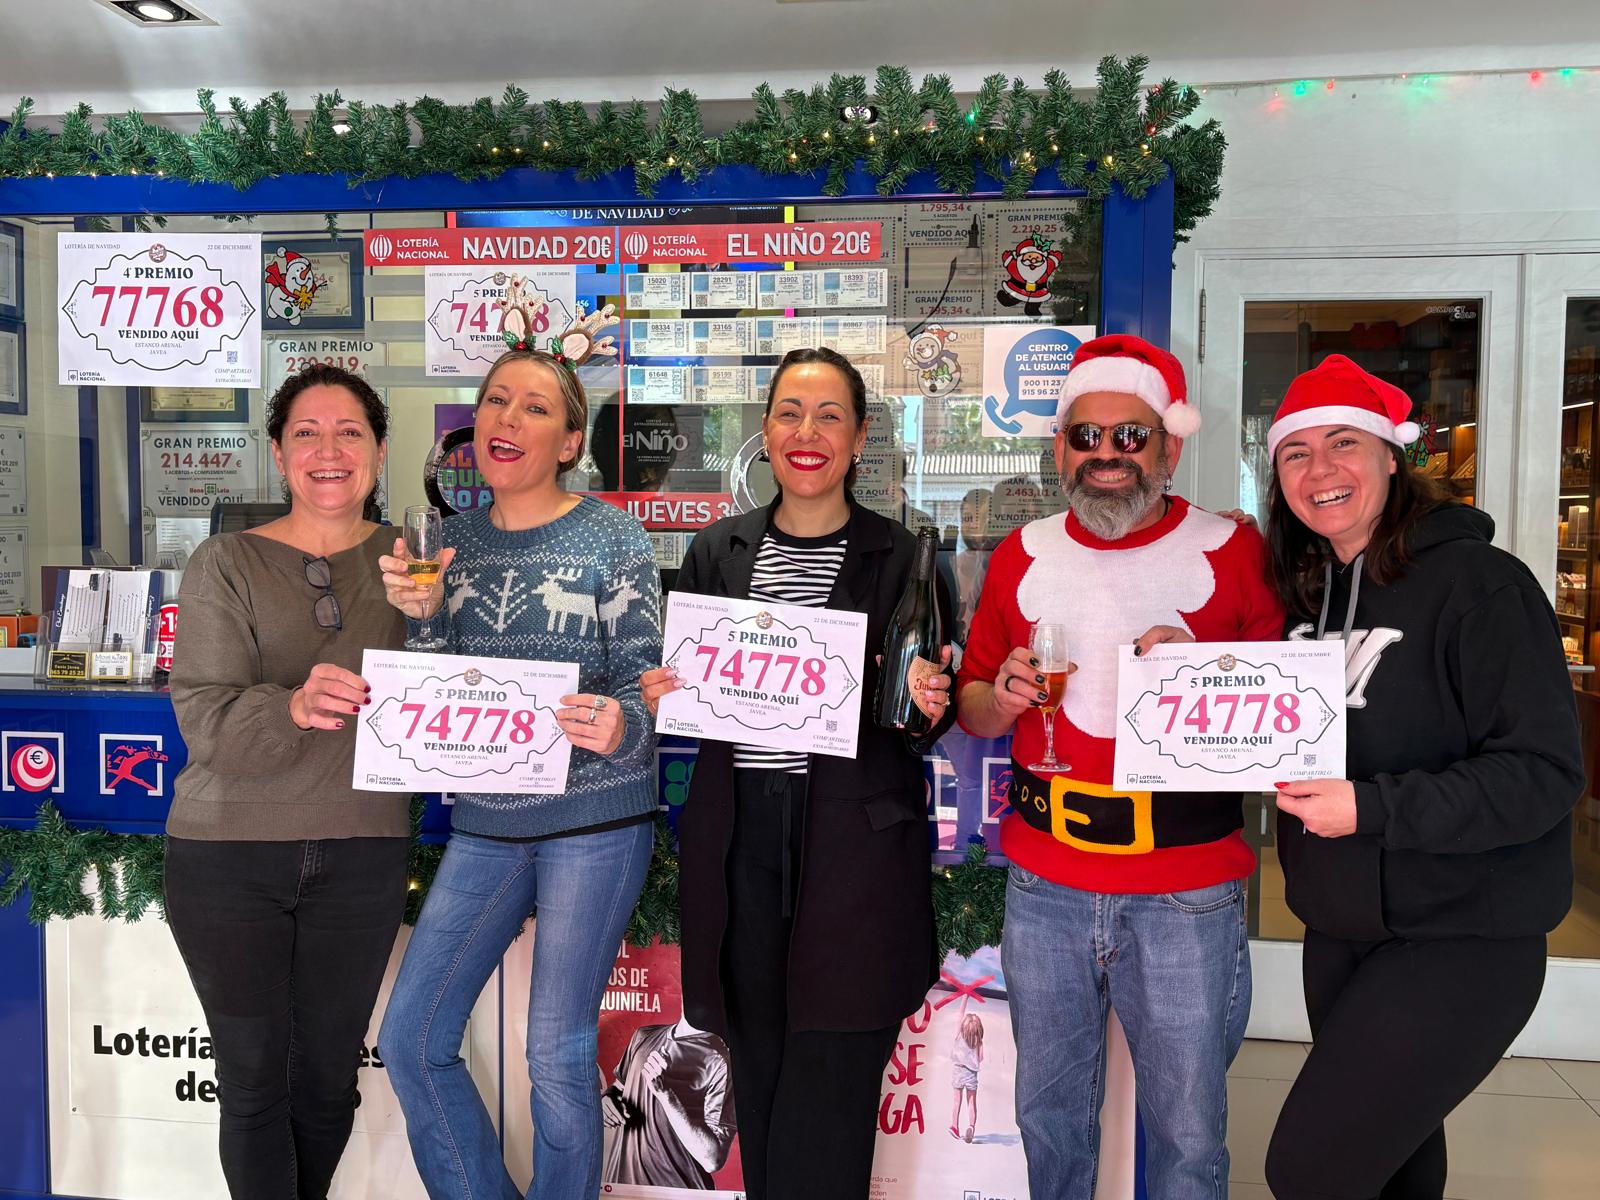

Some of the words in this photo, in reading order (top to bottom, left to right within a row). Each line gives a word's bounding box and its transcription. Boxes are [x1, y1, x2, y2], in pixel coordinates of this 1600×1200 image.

[572, 208, 595, 220] DE
[598, 208, 664, 220] NAVIDAD
[921, 204, 964, 212] 1.795,34
[1012, 224, 1057, 233] 2.219,25
[396, 238, 439, 247] LOTERÍA
[653, 234, 697, 244] LOTERÍA
[728, 234, 758, 257] EL
[764, 227, 825, 256] NIÑO
[831, 230, 870, 255] 20€
[463, 236, 568, 259] NAVIDAD
[573, 236, 612, 258] 20€
[653, 247, 708, 257] NACIONAL
[396, 250, 450, 259] NACIONAL
[134, 268, 194, 279] PREMIO
[92, 286, 224, 328] 77768
[118, 330, 168, 339] VENDIDO
[170, 328, 199, 341] AQUÍ
[279, 342, 317, 352] GRAN
[322, 342, 374, 352] PREMIO
[154, 438, 192, 448] GRAN
[197, 438, 247, 448] PREMIO
[636, 429, 688, 453] Niño
[160, 453, 232, 468] 214.447
[236, 459, 242, 468] €
[158, 496, 210, 506] VENDIDO
[627, 501, 711, 522] JUEVES
[673, 601, 694, 609] LOTERÍA
[739, 632, 798, 648] PREMIO
[695, 645, 826, 696] 74778
[1202, 675, 1266, 688] PREMIO
[447, 689, 508, 702] PREMIO
[719, 686, 768, 701] VENDIDO
[770, 694, 800, 706] AQUÍ
[1157, 693, 1300, 734] 74778
[400, 703, 536, 744] 74778
[1184, 736, 1238, 745] VENDIDO
[1241, 734, 1273, 747] AQUÍ
[424, 742, 475, 752] VENDIDO
[478, 744, 507, 754] AQUÍ
[631, 968, 649, 988] DE
[888, 1042, 926, 1086] SE
